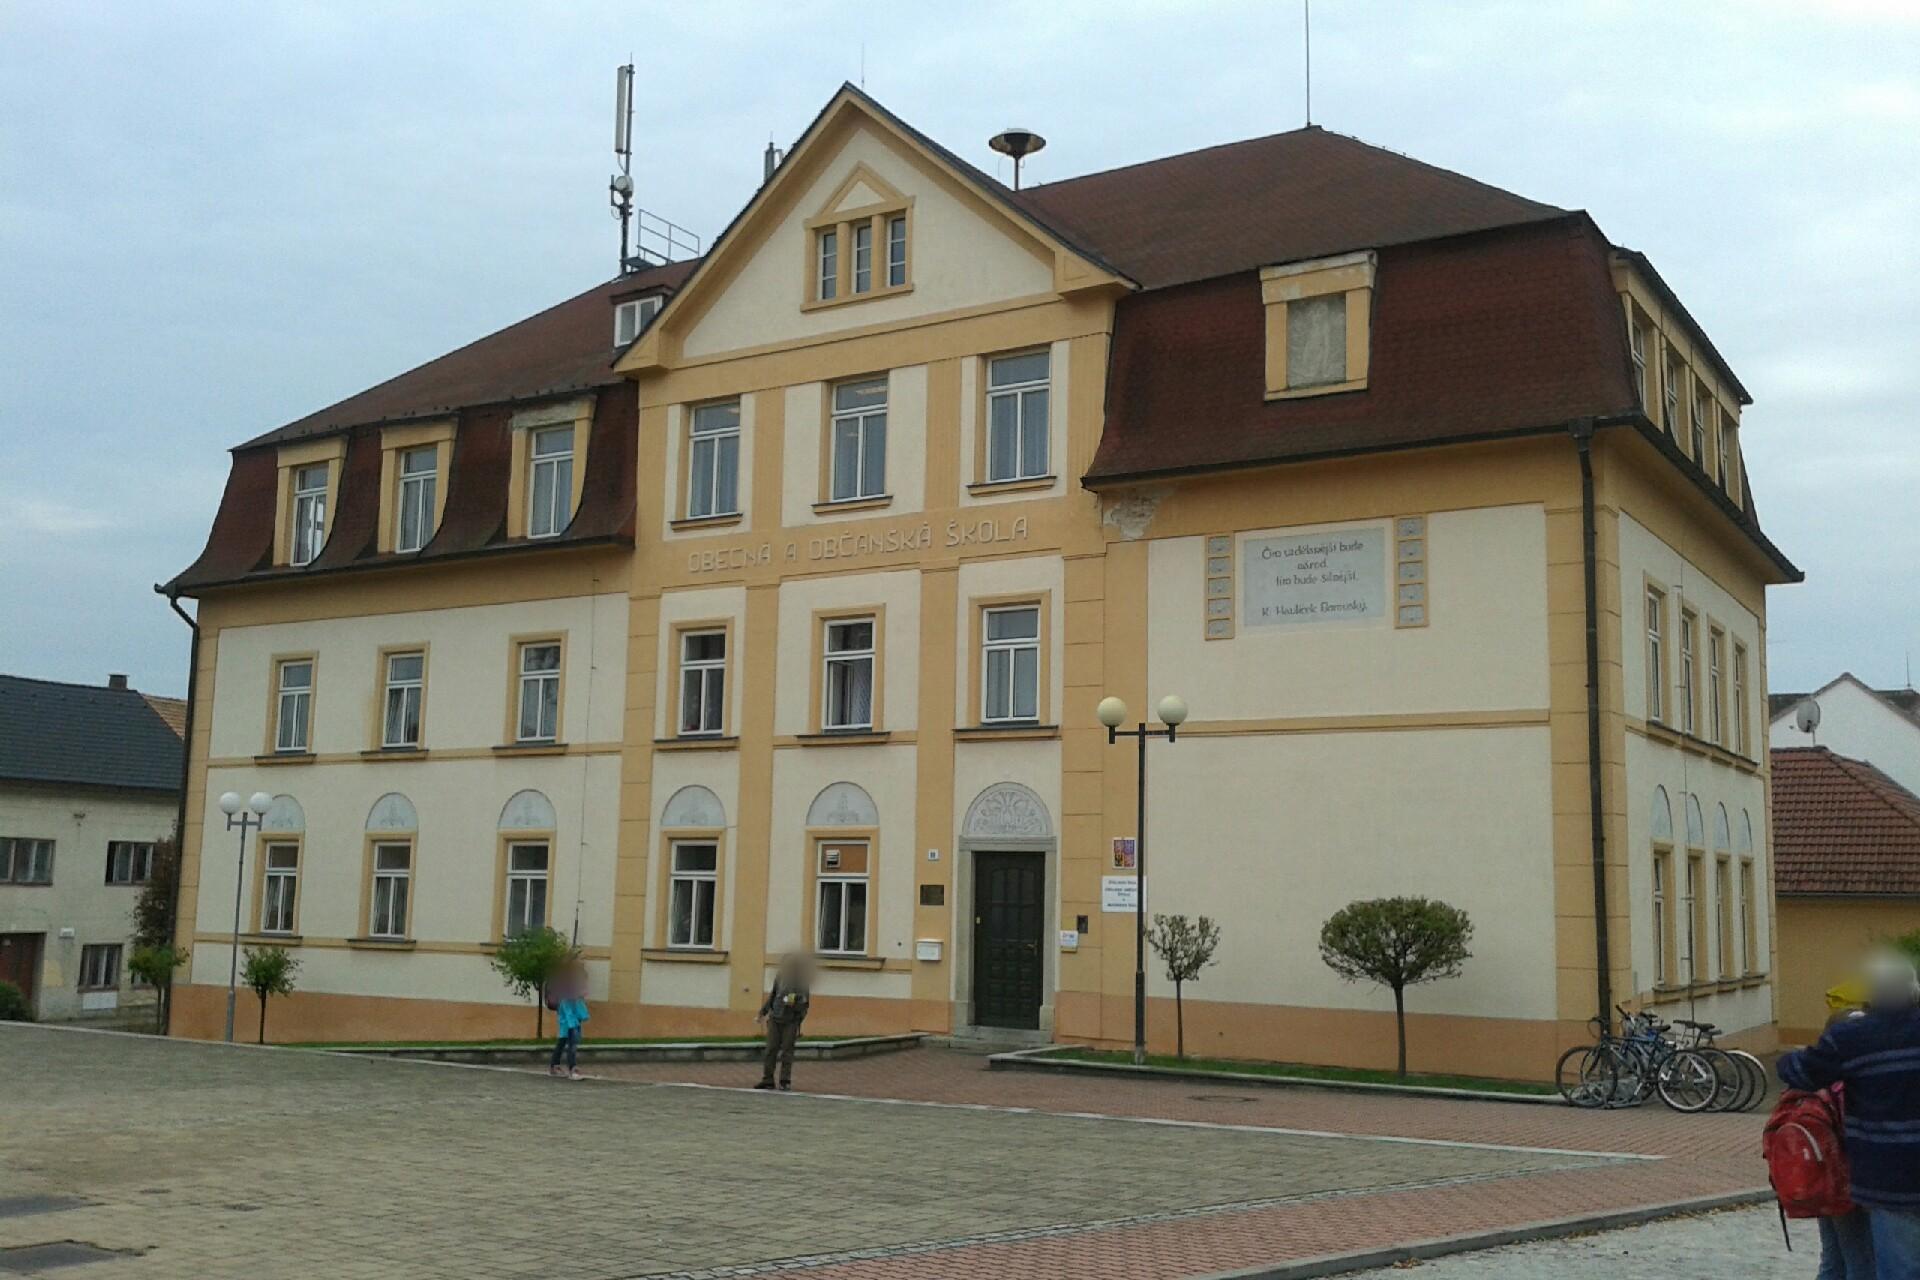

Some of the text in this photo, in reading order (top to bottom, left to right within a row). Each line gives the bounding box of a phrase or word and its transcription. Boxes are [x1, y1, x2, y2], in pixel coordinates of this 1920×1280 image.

[688, 515, 1029, 573] OBECNÁ A OBČANSKÁ ŠKOLA
